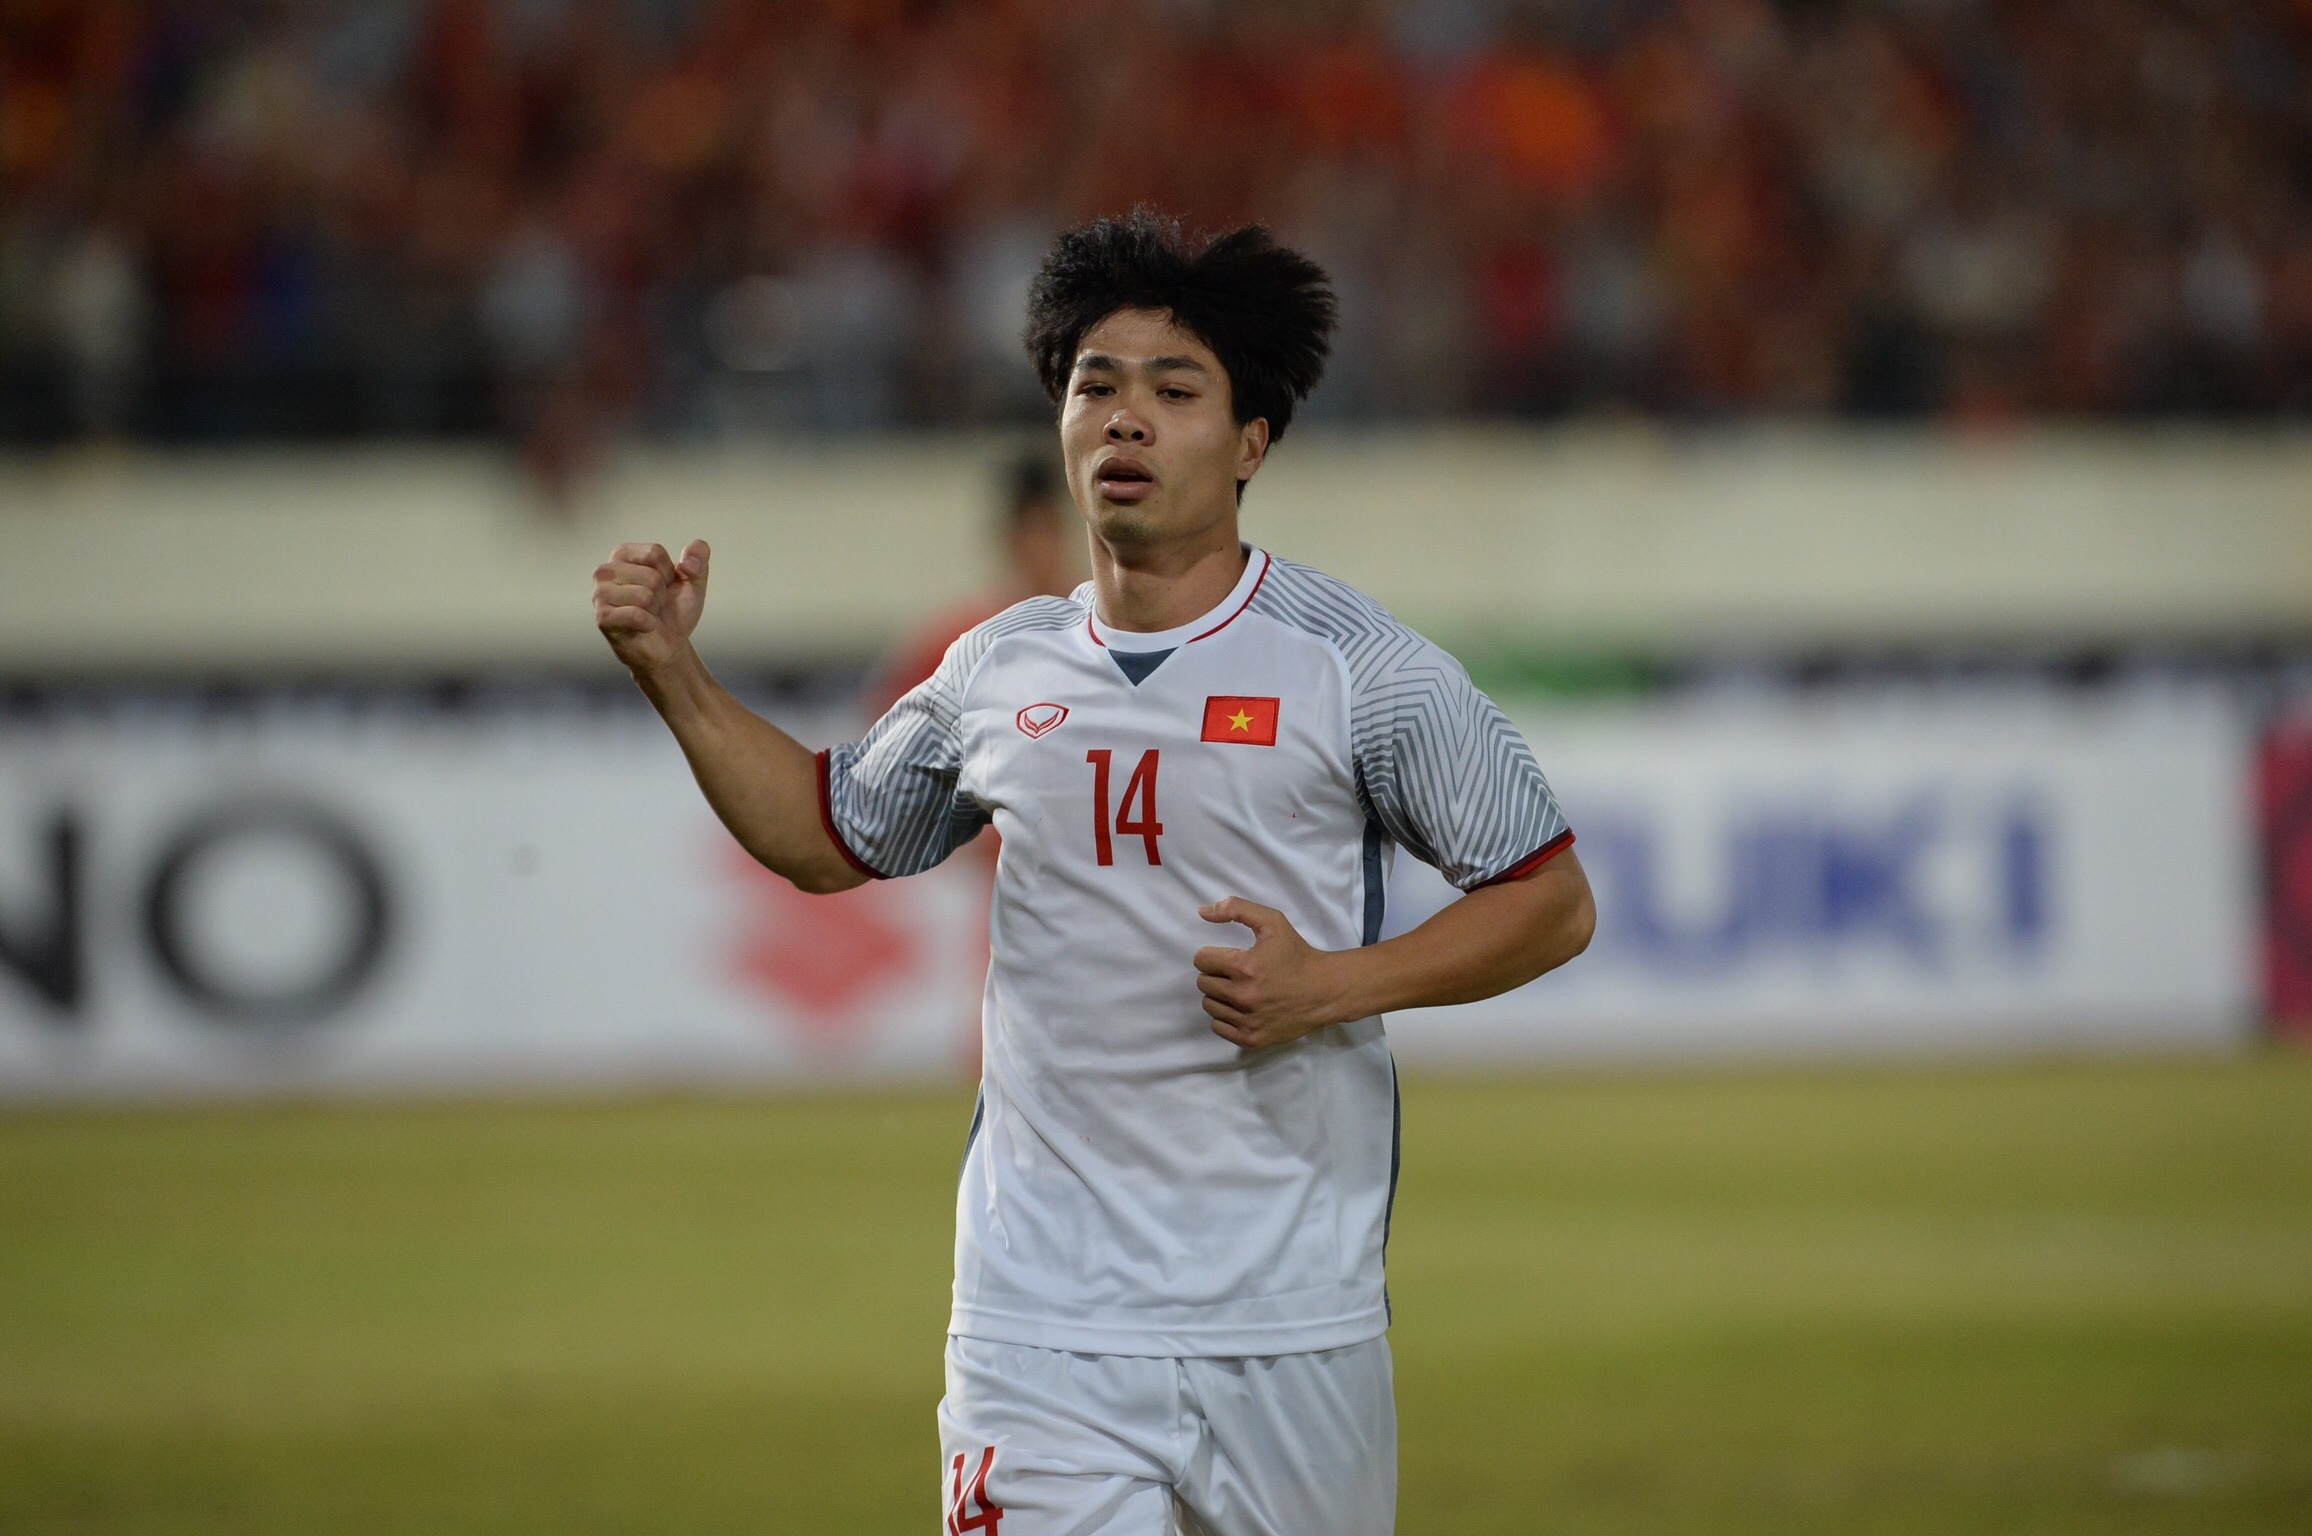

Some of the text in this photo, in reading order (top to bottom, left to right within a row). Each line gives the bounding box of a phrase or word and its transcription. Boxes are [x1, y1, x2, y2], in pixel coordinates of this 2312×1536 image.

[1086, 749, 1163, 866] 14
[1545, 795, 2056, 985] UKI
[948, 1446, 1004, 1536] 14
